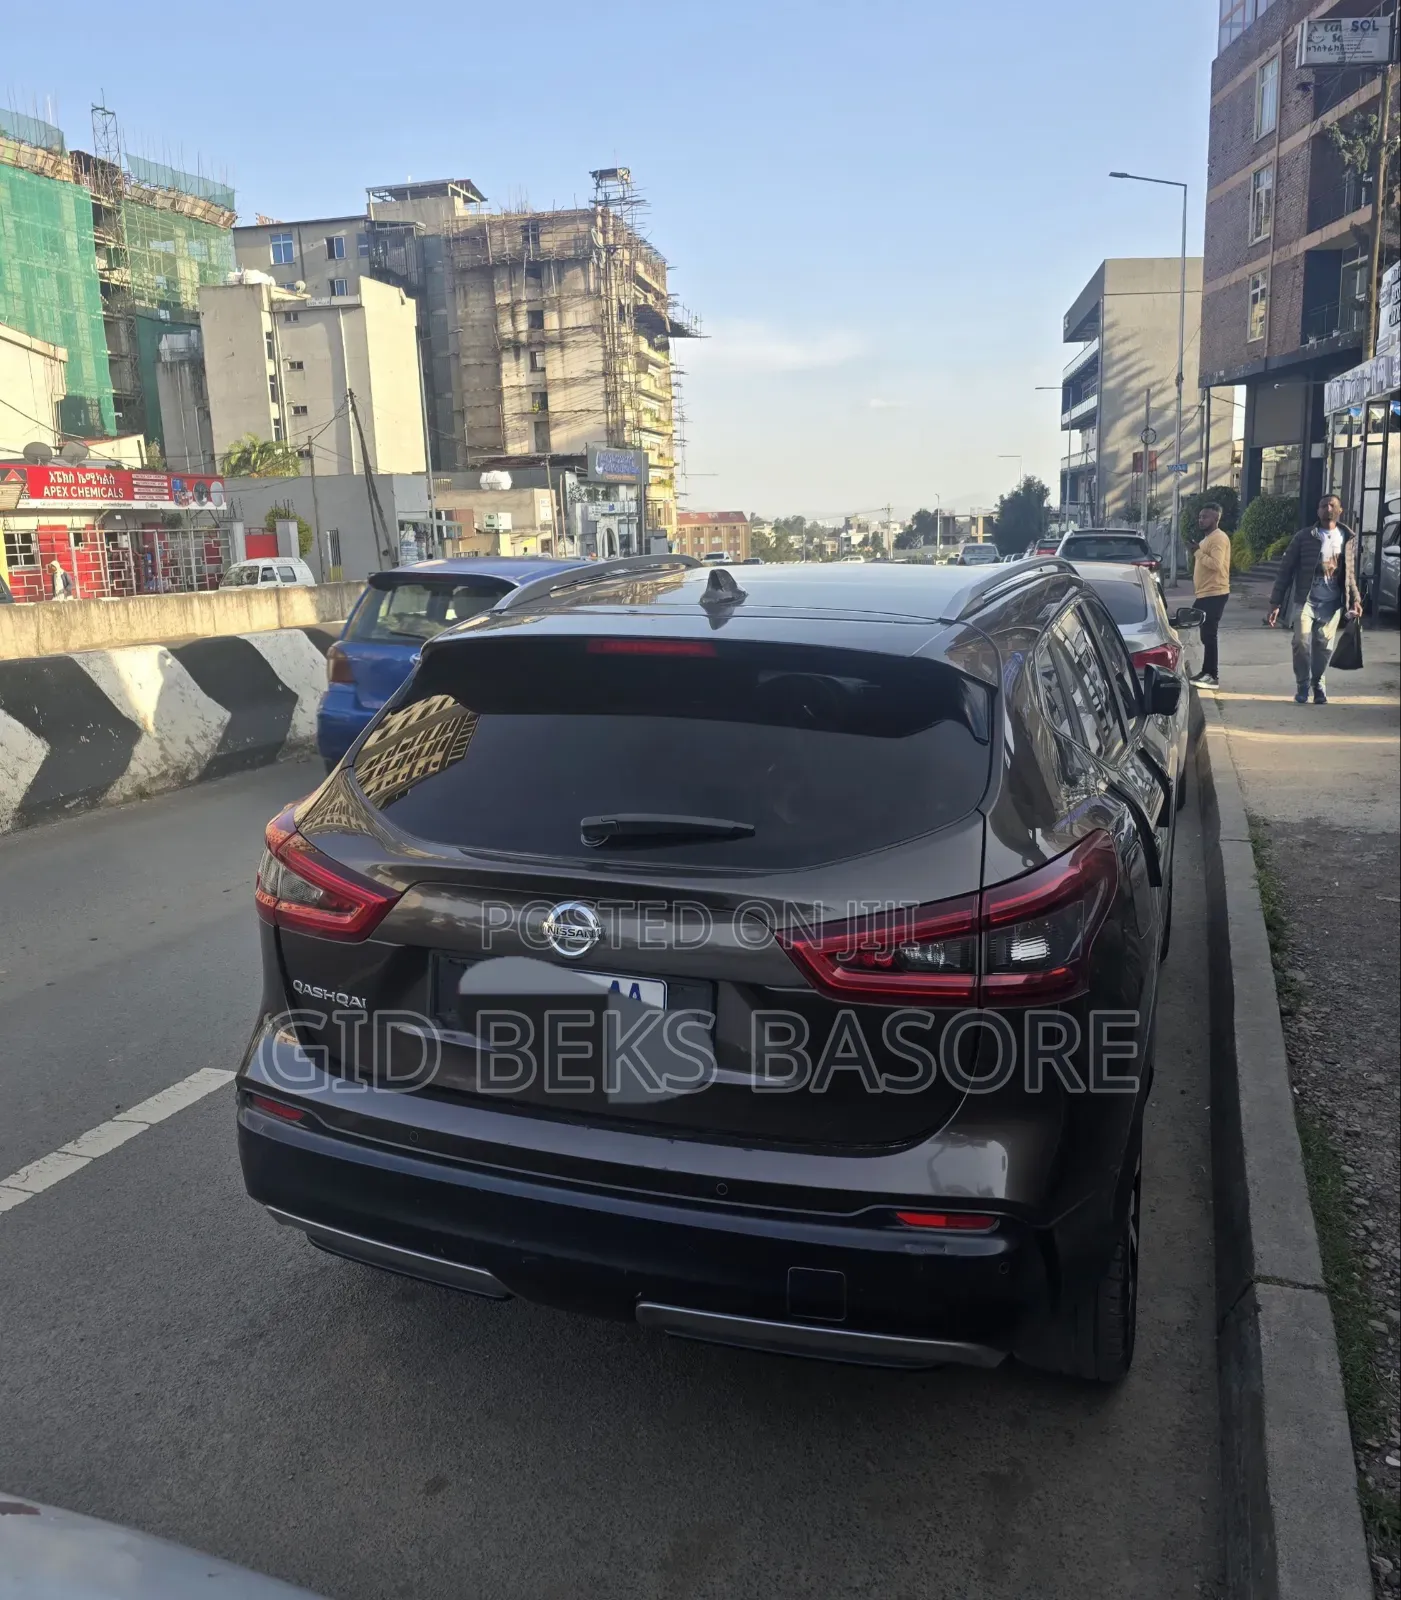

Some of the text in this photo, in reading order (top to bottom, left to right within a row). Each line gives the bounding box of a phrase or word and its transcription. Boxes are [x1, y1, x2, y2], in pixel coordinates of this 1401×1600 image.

[1351, 20, 1379, 32] SOL
[43, 485, 69, 497] APEX
[70, 486, 124, 498] CHEMICALS
[547, 925, 594, 938] NISSAN
[292, 979, 367, 1009] QASHQAI
